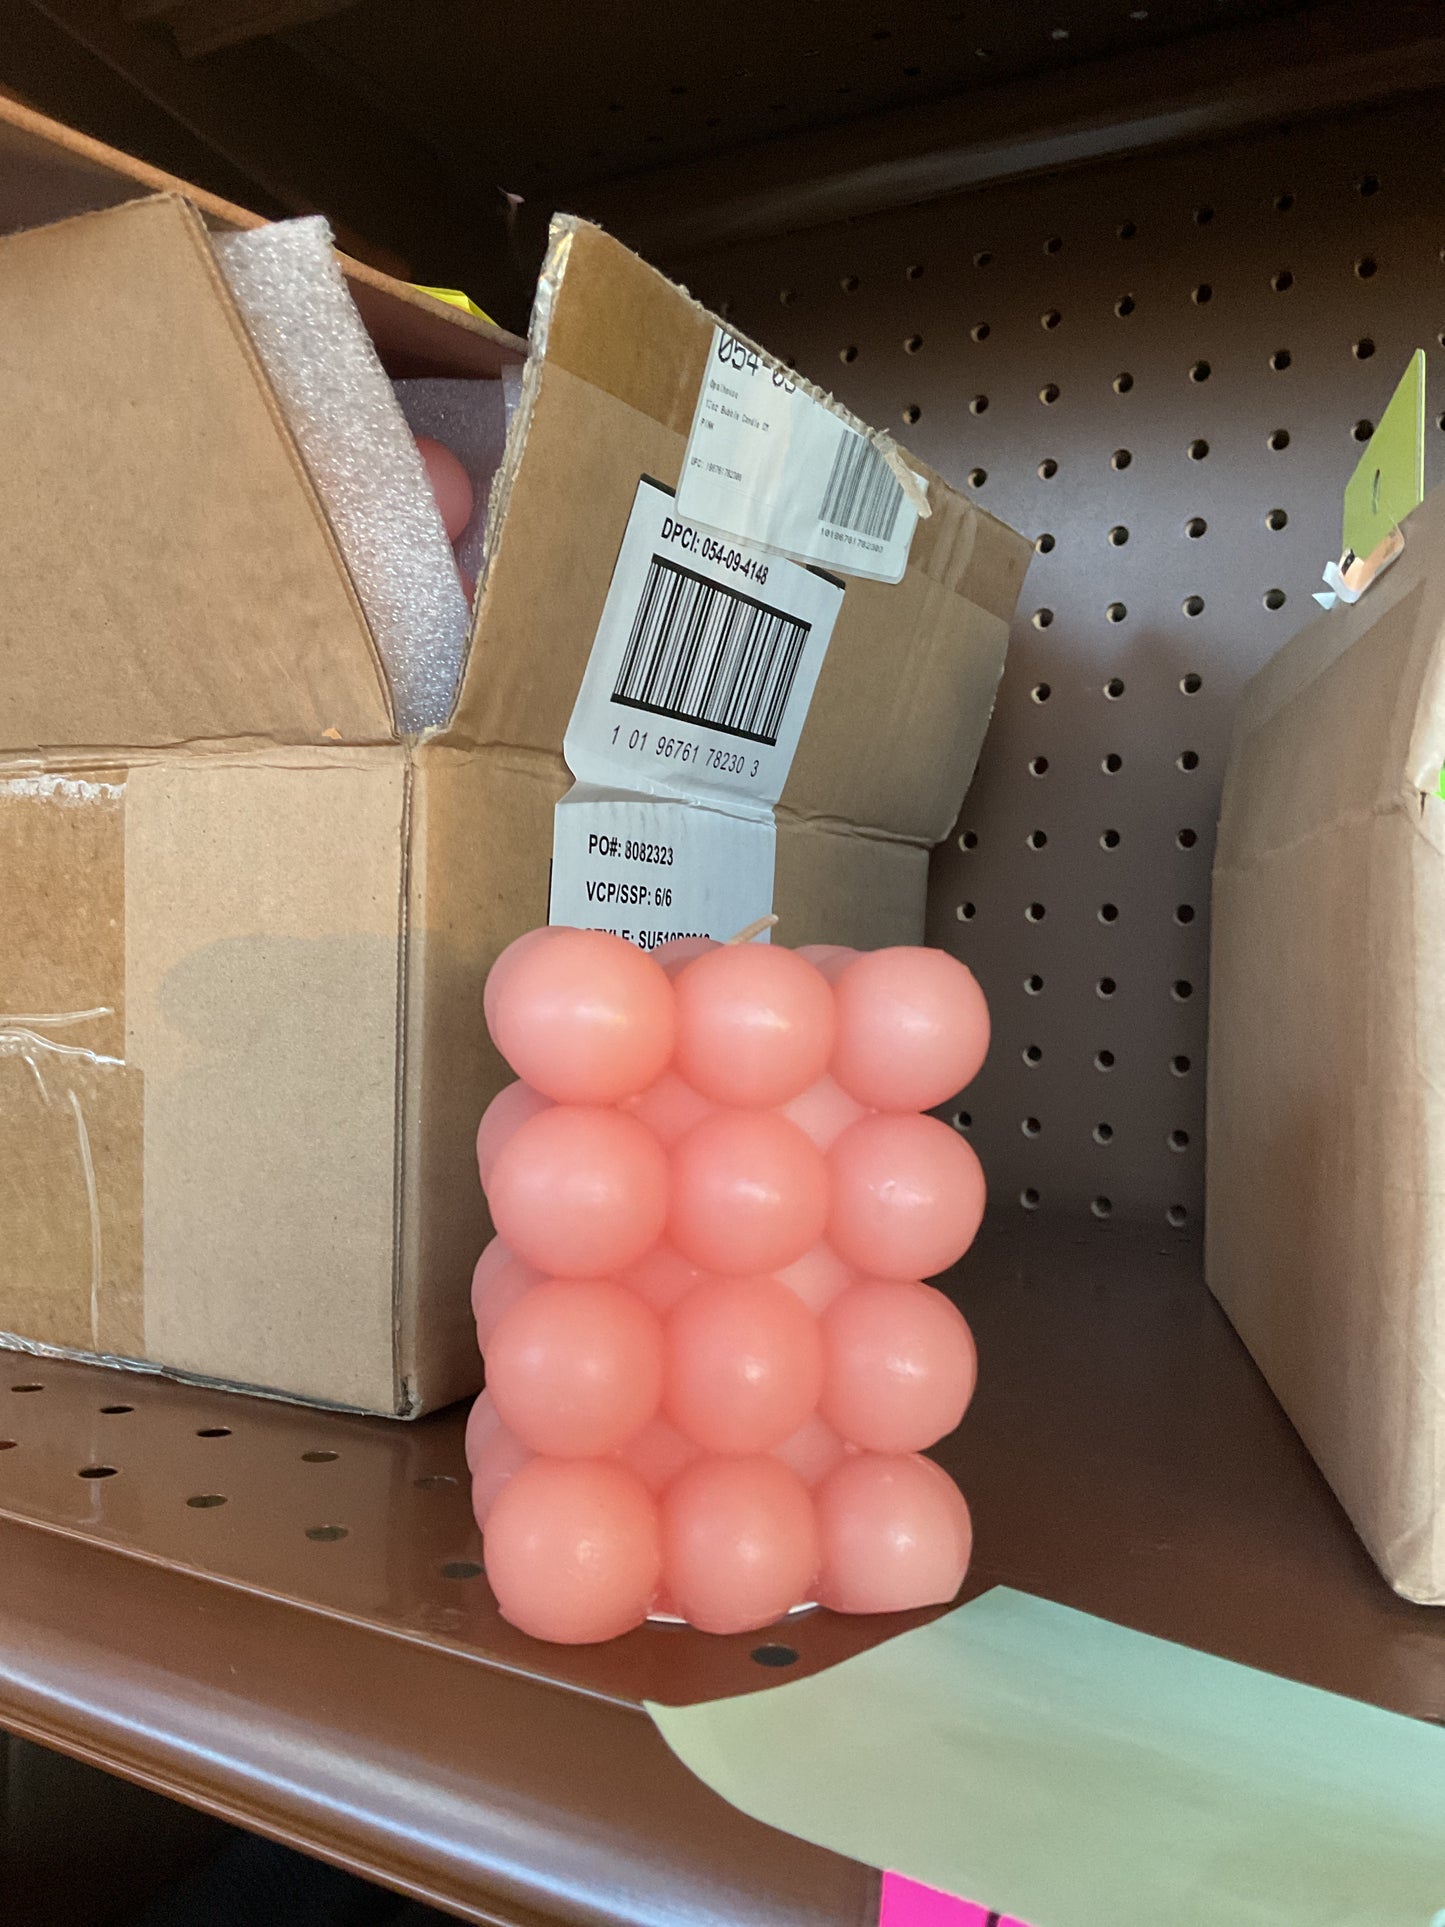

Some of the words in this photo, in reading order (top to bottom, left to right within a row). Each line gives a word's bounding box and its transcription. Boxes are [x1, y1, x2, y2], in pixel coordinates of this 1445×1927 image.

[661, 517, 700, 553] DPCI:
[702, 538, 768, 585] 054-09-4148
[612, 725, 620, 745] 1
[629, 729, 648, 751] 01
[656, 736, 699, 764] 96761
[706, 748, 745, 774] 78230
[751, 760, 760, 778] 3
[588, 833, 622, 858] PO#:
[625, 840, 674, 866] 8082323
[586, 880, 651, 906] VCP/SSP:
[655, 887, 672, 907] 6/6
